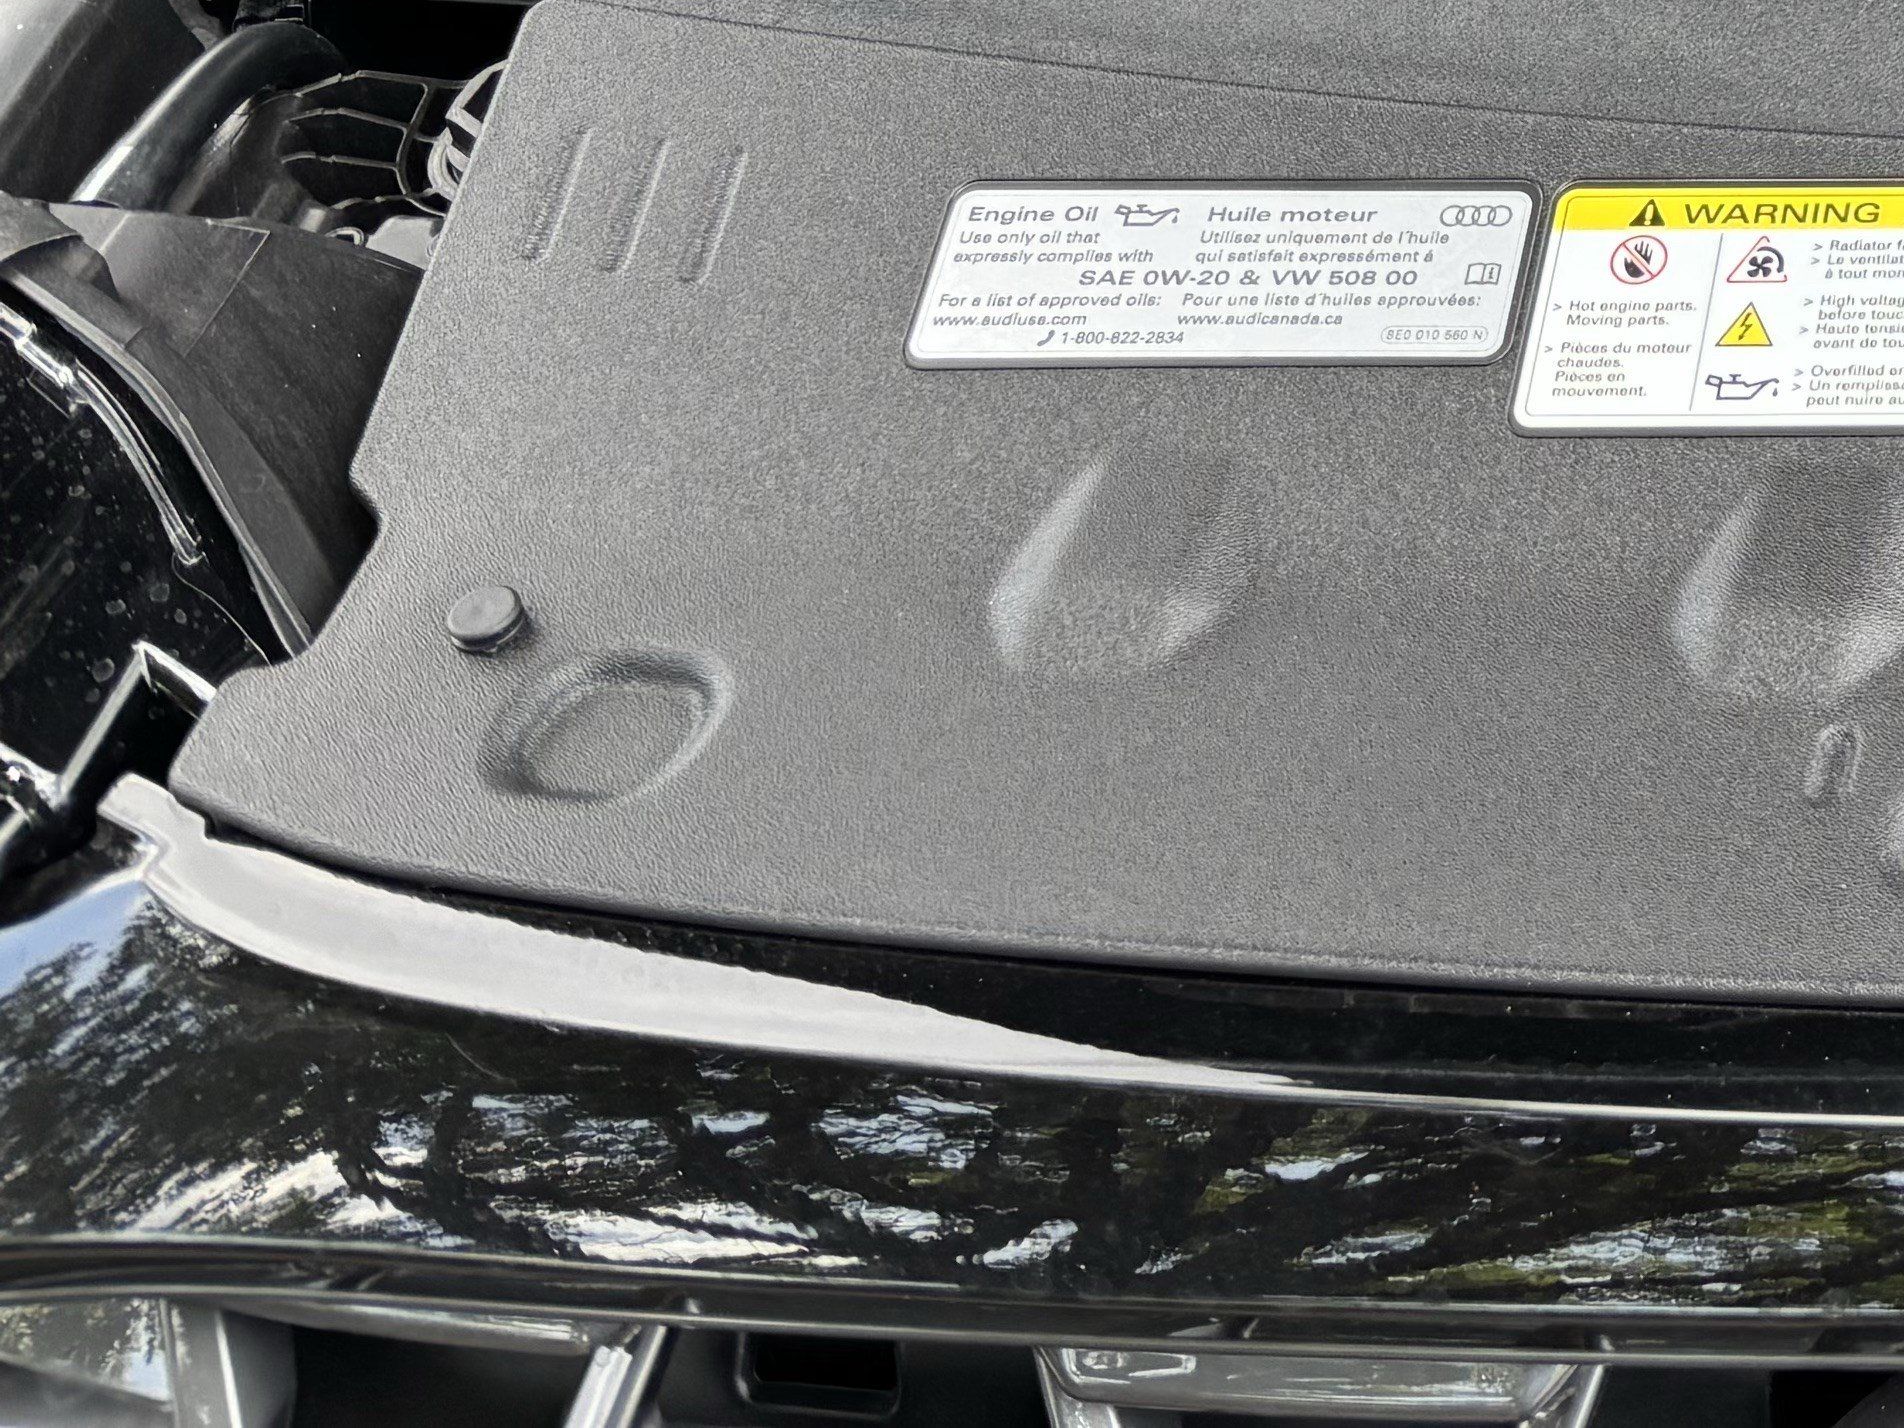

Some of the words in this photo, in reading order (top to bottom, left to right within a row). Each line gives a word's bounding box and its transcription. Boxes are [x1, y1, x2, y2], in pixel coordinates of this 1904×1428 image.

[969, 206, 1054, 225] Engine
[1065, 206, 1098, 221] Oil
[1207, 207, 1271, 222] Huile
[1281, 208, 1378, 222] moteur
[1685, 202, 1880, 224] WARNING
[960, 231, 992, 244] Use
[997, 231, 1036, 246] only
[1040, 231, 1062, 244] oil
[1067, 231, 1100, 244] that
[1200, 230, 1261, 243] Utilisez
[1266, 231, 1367, 246] uniquement
[1373, 231, 1392, 244] de
[1830, 240, 1892, 251] Radiator
[954, 250, 1033, 265] expressly
[1037, 250, 1112, 265] complies
[1118, 249, 1153, 262] with
[1195, 249, 1223, 264] qui
[1227, 249, 1294, 262] satisfait
[1299, 249, 1412, 265] expressément
[1828, 254, 1844, 265] Le
[1079, 270, 1135, 285] SAE
[1143, 270, 1230, 285] 0W-20
[1239, 270, 1260, 285] &
[1273, 270, 1321, 285] VW
[1329, 271, 1377, 285] 508
[1386, 271, 1417, 286] 00
[1839, 269, 1867, 279] tout
[939, 294, 967, 307] For
[972, 297, 981, 306] a
[987, 293, 1012, 306] list
[1017, 293, 1036, 306] of
[1039, 294, 1122, 309] approved
[1126, 293, 1161, 306] oils:
[1182, 293, 1223, 306] Pour
[1228, 296, 1258, 306] une
[1265, 293, 1299, 306] liste
[1377, 293, 1481, 309] approuvées:
[1570, 301, 1595, 311] Hot
[1600, 303, 1650, 313] engine
[1655, 301, 1696, 312] parts.
[1821, 295, 1854, 311] High
[933, 313, 1086, 326] www.audiusa.com
[1178, 312, 1342, 325] www.audicanada.ca
[1567, 314, 1622, 327] Moving
[1628, 315, 1668, 327] parts.
[1818, 309, 1866, 320] before
[1416, 329, 1440, 340] 010
[1444, 330, 1468, 340] 560
[1474, 330, 1483, 340] N
[1816, 323, 1859, 334] Haute
[1063, 331, 1184, 344] 1-800-822-2834
[1813, 339, 1854, 348] avant
[1860, 338, 1877, 348] de
[1561, 342, 1607, 353] Pièces
[1613, 342, 1631, 353] du
[1637, 344, 1691, 353] moteur
[1557, 357, 1624, 368] chaudes.
[1555, 371, 1602, 382] Pièces
[1607, 373, 1625, 382] en
[1811, 365, 1885, 377] Overfilled
[1552, 386, 1646, 396] mouvement.
[1809, 380, 1830, 391] Un
[1806, 396, 1839, 407] peut
[1845, 392, 1883, 405] nuire
